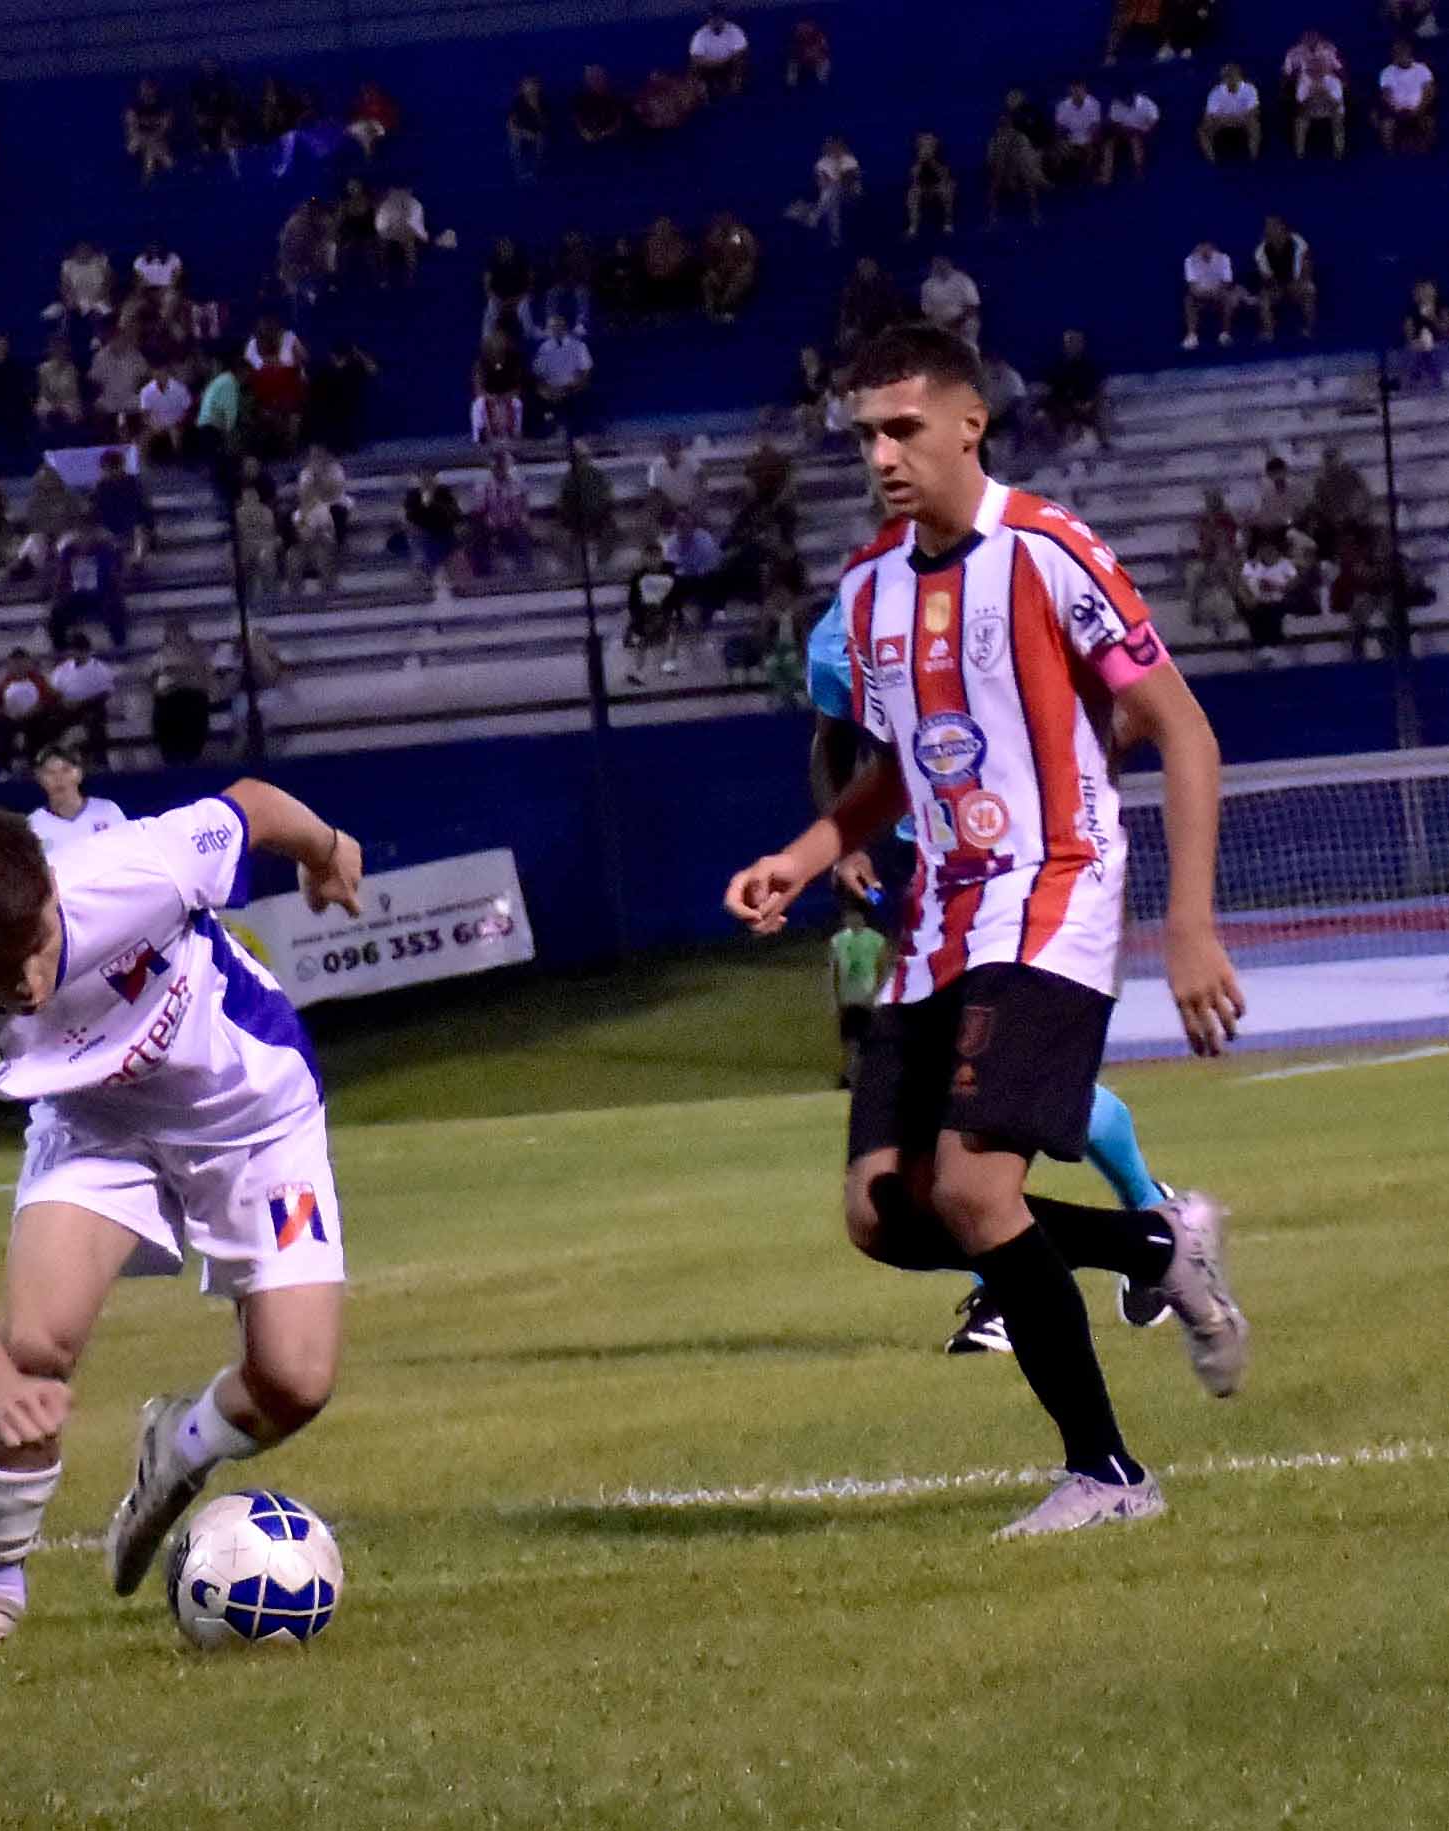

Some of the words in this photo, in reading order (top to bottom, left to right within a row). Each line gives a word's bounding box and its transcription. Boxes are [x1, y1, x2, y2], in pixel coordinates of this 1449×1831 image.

[190, 823, 232, 854] antel
[322, 940, 381, 974] 096
[388, 927, 444, 960] 353
